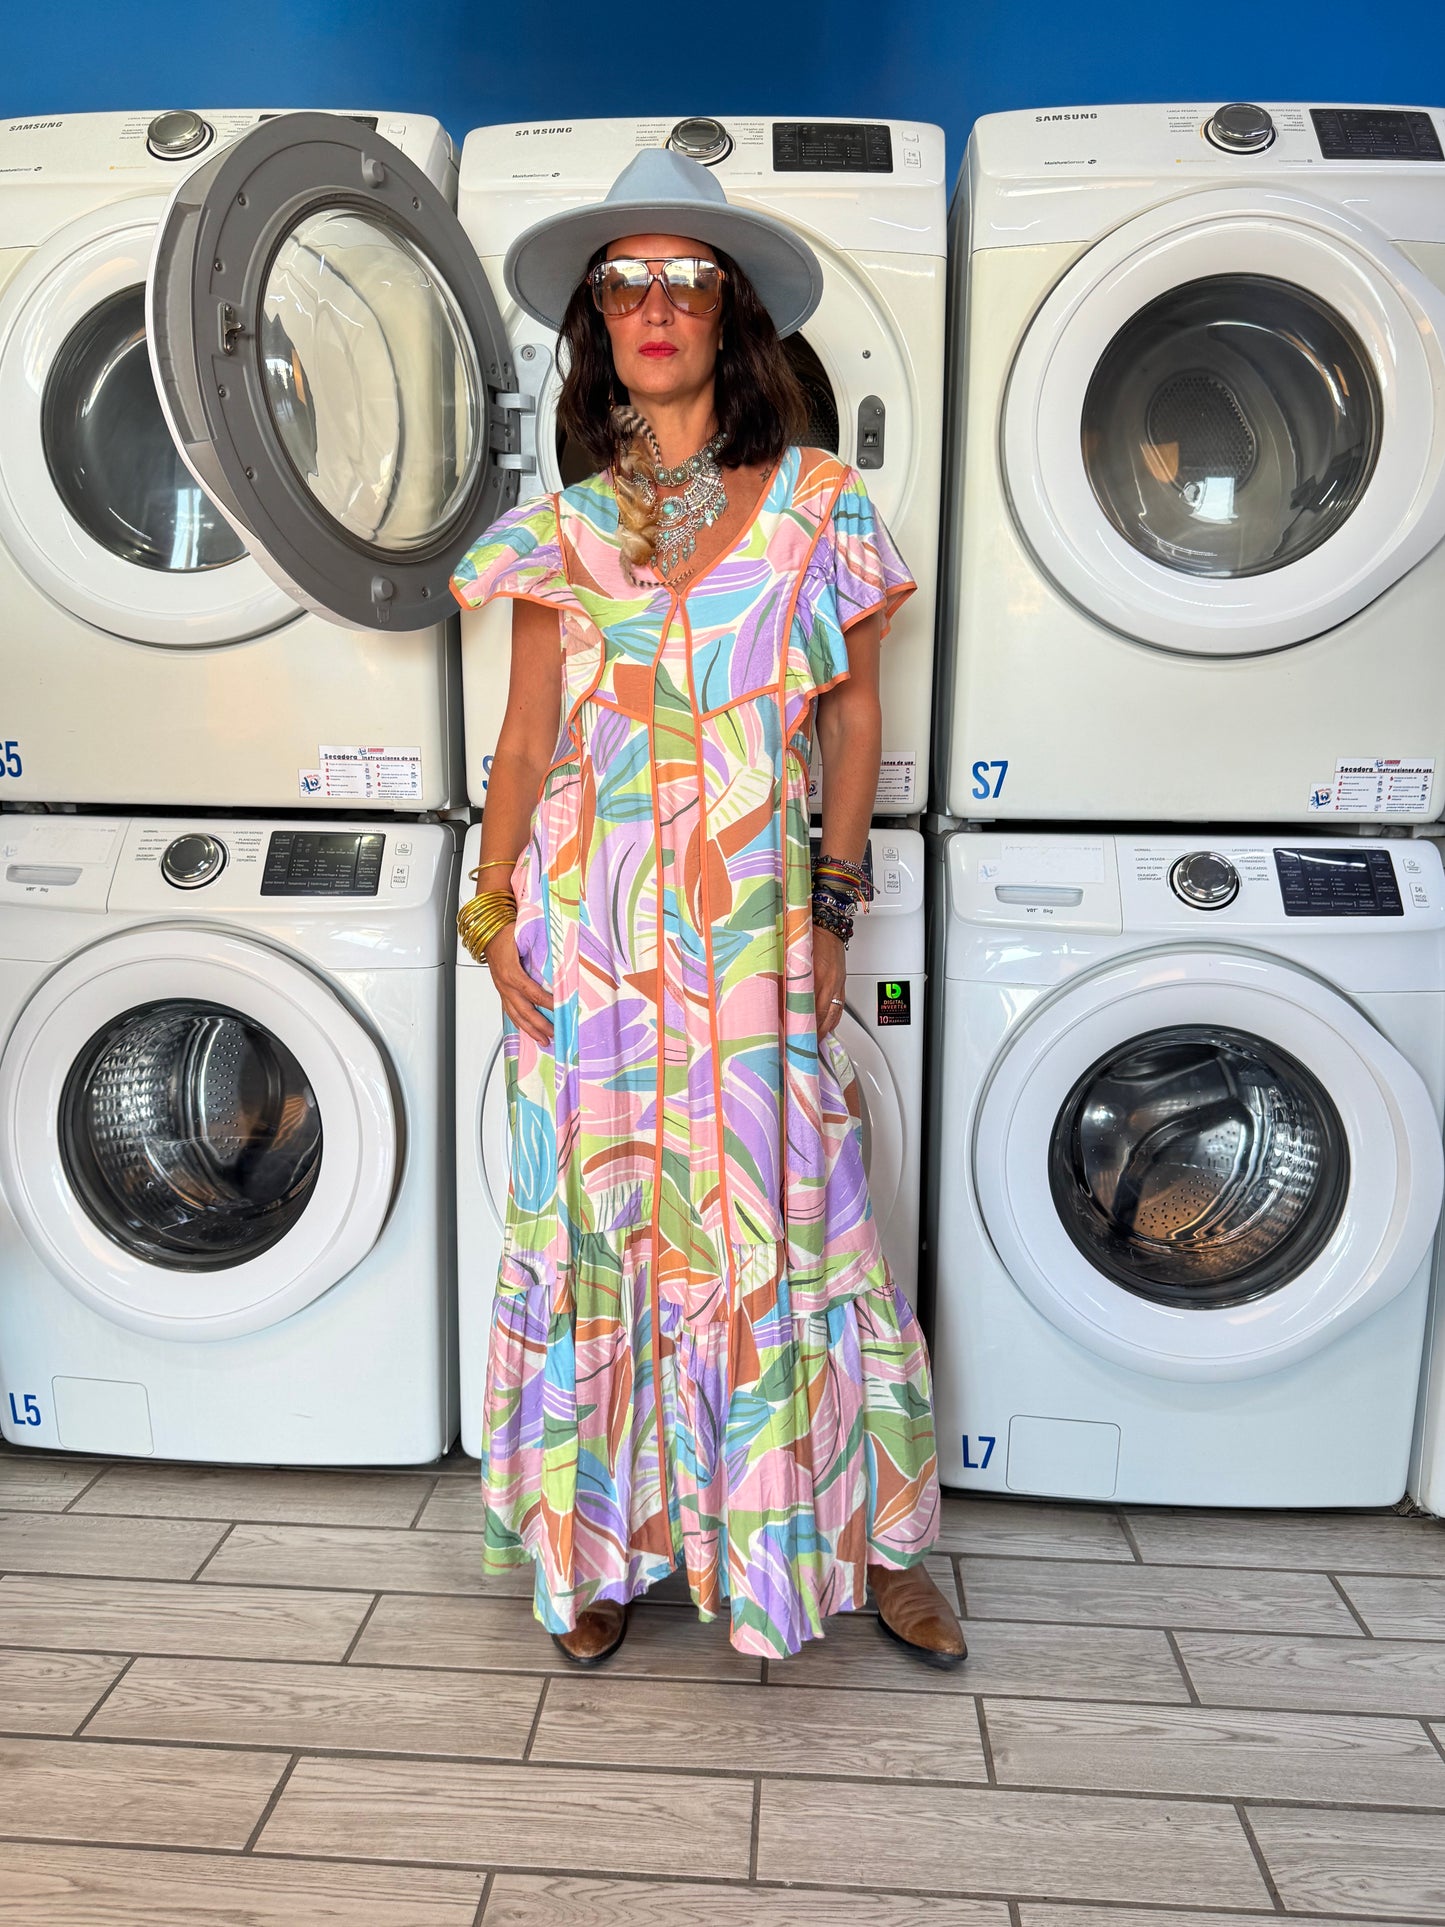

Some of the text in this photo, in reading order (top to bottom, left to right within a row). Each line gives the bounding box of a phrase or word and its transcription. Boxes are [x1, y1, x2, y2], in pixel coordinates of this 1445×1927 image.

[9, 122, 63, 131] SAMSUNG
[1035, 113, 1098, 122] SAMSUNG
[972, 760, 1008, 799] S7
[879, 1015, 889, 1024] 10
[9, 1392, 41, 1426] L5
[962, 1435, 996, 1469] L7
